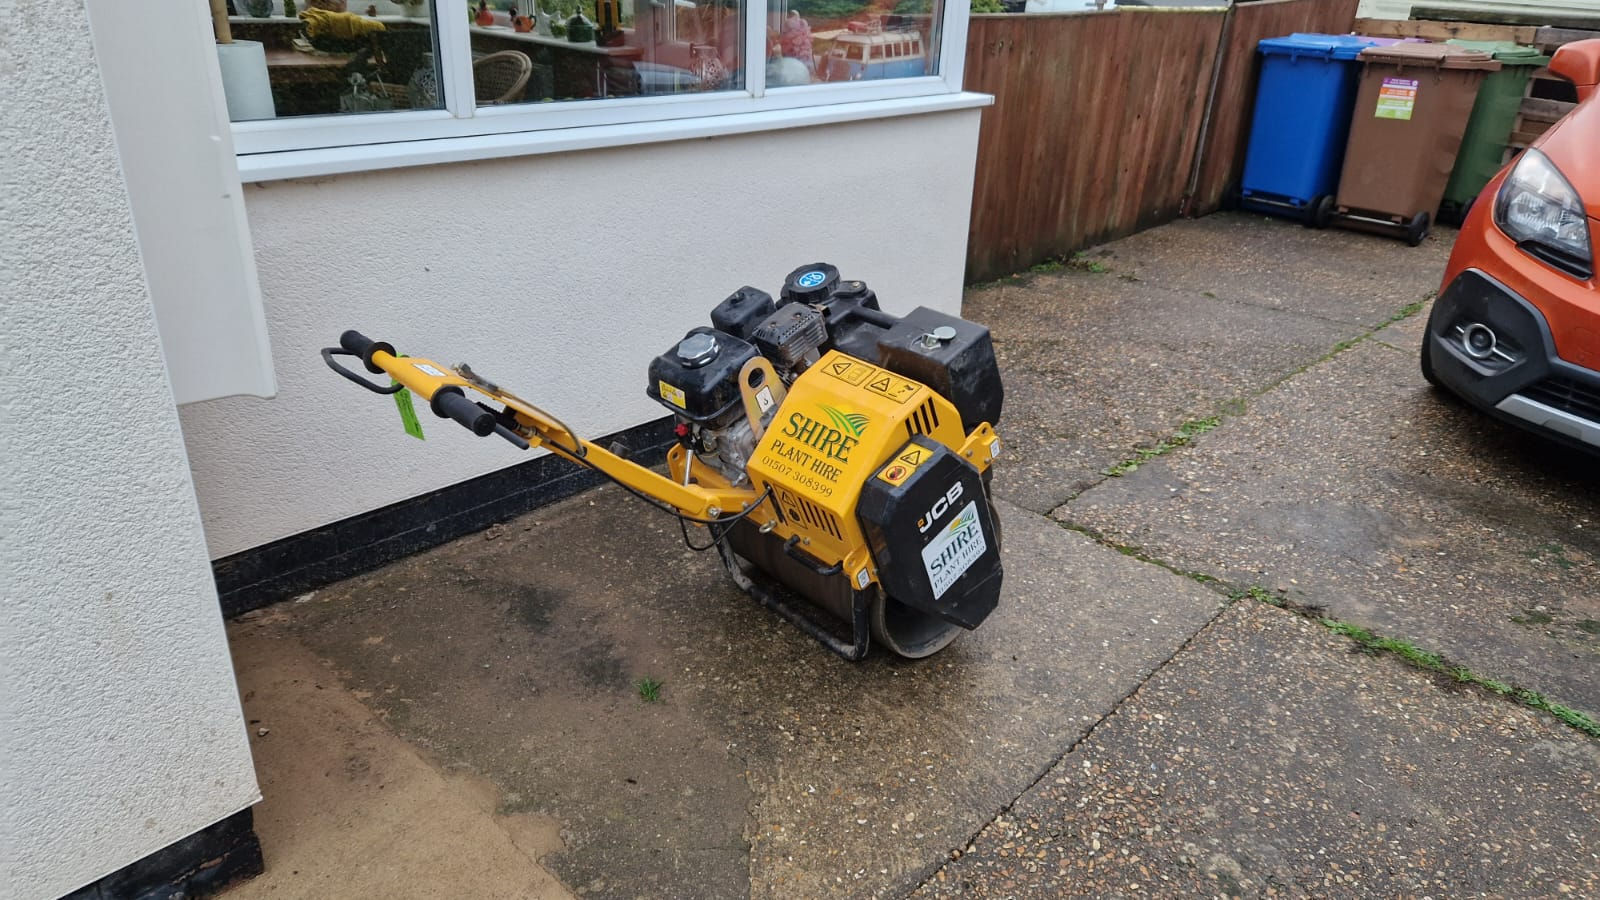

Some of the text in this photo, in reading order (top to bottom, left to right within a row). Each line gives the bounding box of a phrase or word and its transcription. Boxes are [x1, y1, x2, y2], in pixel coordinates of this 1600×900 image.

[771, 439, 842, 483] PLANT HIRE
[782, 412, 859, 464] SHIRE
[762, 455, 833, 497] 01507 308399
[919, 481, 964, 534] JCB
[930, 520, 979, 577] SHIRE
[934, 535, 983, 589] PLANT HIRE
